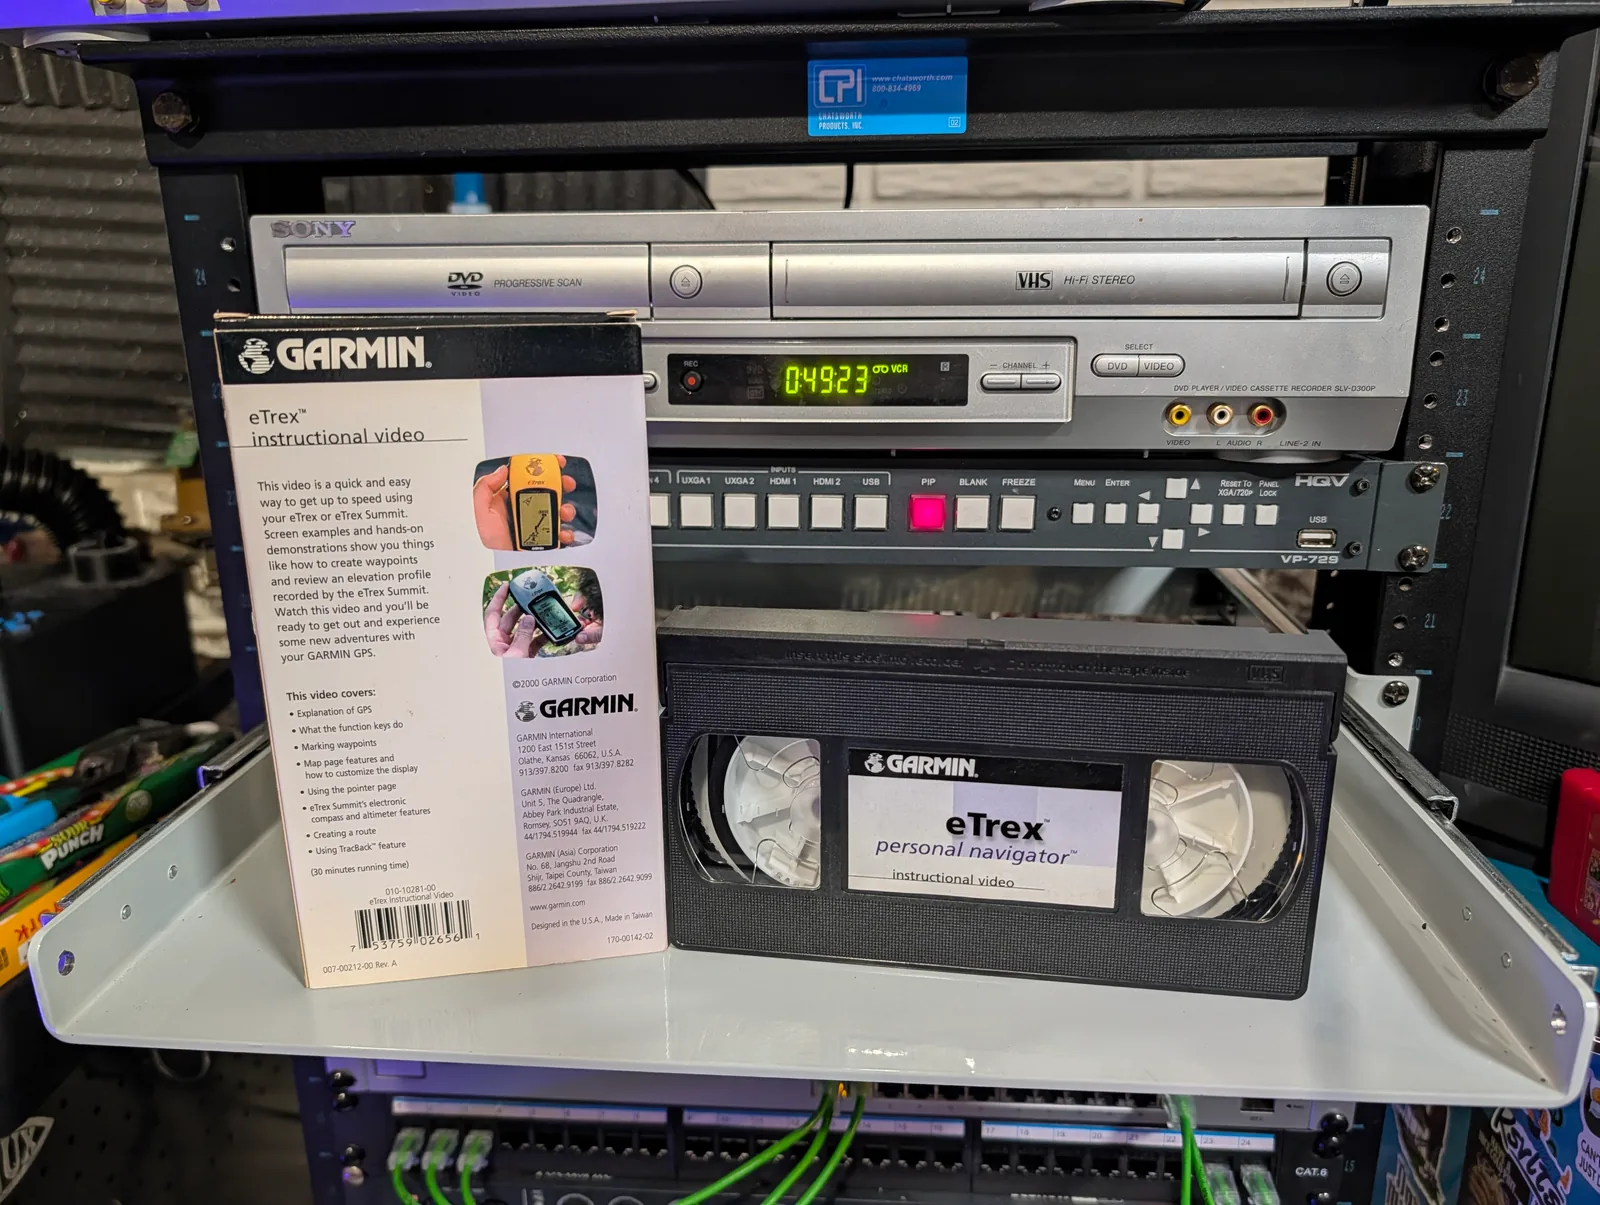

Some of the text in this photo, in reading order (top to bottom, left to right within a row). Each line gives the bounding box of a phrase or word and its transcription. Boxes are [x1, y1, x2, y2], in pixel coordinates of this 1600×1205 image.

[872, 74, 953, 82] www.chatsworth.com
[819, 68, 862, 103] CPI
[819, 112, 863, 120] CHATSWORTH
[271, 220, 356, 239] SONY
[448, 272, 483, 283] DVD
[1017, 272, 1051, 289] VHS
[1063, 275, 1135, 285] Hi-Fi STEREO
[1473, 266, 1486, 285] 24
[494, 279, 582, 288] PROGRESSIVE SCAN
[891, 364, 908, 374] VCR
[1107, 362, 1128, 370] DVD
[1144, 362, 1175, 370] VIDEO
[785, 365, 869, 395] 0:49:23
[1455, 389, 1469, 406] 23
[252, 427, 424, 447] instructional video
[257, 481, 279, 492] This
[282, 480, 311, 490] video
[314, 479, 322, 489] is
[334, 478, 363, 490] quick
[366, 477, 386, 488] and
[389, 478, 411, 488] easy
[682, 477, 706, 485] UXGA
[725, 477, 755, 486] UXGA 2
[770, 477, 790, 486] HDMI
[813, 478, 840, 486] HDMI 2
[862, 478, 880, 486] USB
[921, 478, 936, 486] PIP
[959, 478, 987, 487] BLANK
[1002, 479, 1036, 487] FREEZE
[1294, 476, 1350, 487] HQV
[259, 493, 413, 509] way to get up to speed using
[1309, 516, 1327, 524] USB
[264, 524, 424, 539] Screen examples and hands-on
[1281, 555, 1339, 565] VP-729
[271, 570, 431, 586] and review an elevation profile
[542, 677, 573, 687] GARMIN
[574, 674, 617, 685] Corporation
[286, 688, 376, 701] This video covers:
[299, 721, 403, 735] What the function keys do
[516, 728, 593, 742] GARMIN International
[518, 740, 596, 754] 1200 East 151st Street
[41, 823, 105, 870] PUNCH
[875, 840, 964, 857] personal
[892, 869, 1015, 888] instructional video
[385, 884, 436, 896] 010-10281-00
[530, 899, 586, 911] www.garmin.com
[607, 932, 653, 944] 170-00142-02
[323, 959, 397, 974] 007-00212-00 Rev. A
[1295, 1166, 1328, 1177] CAT.6
